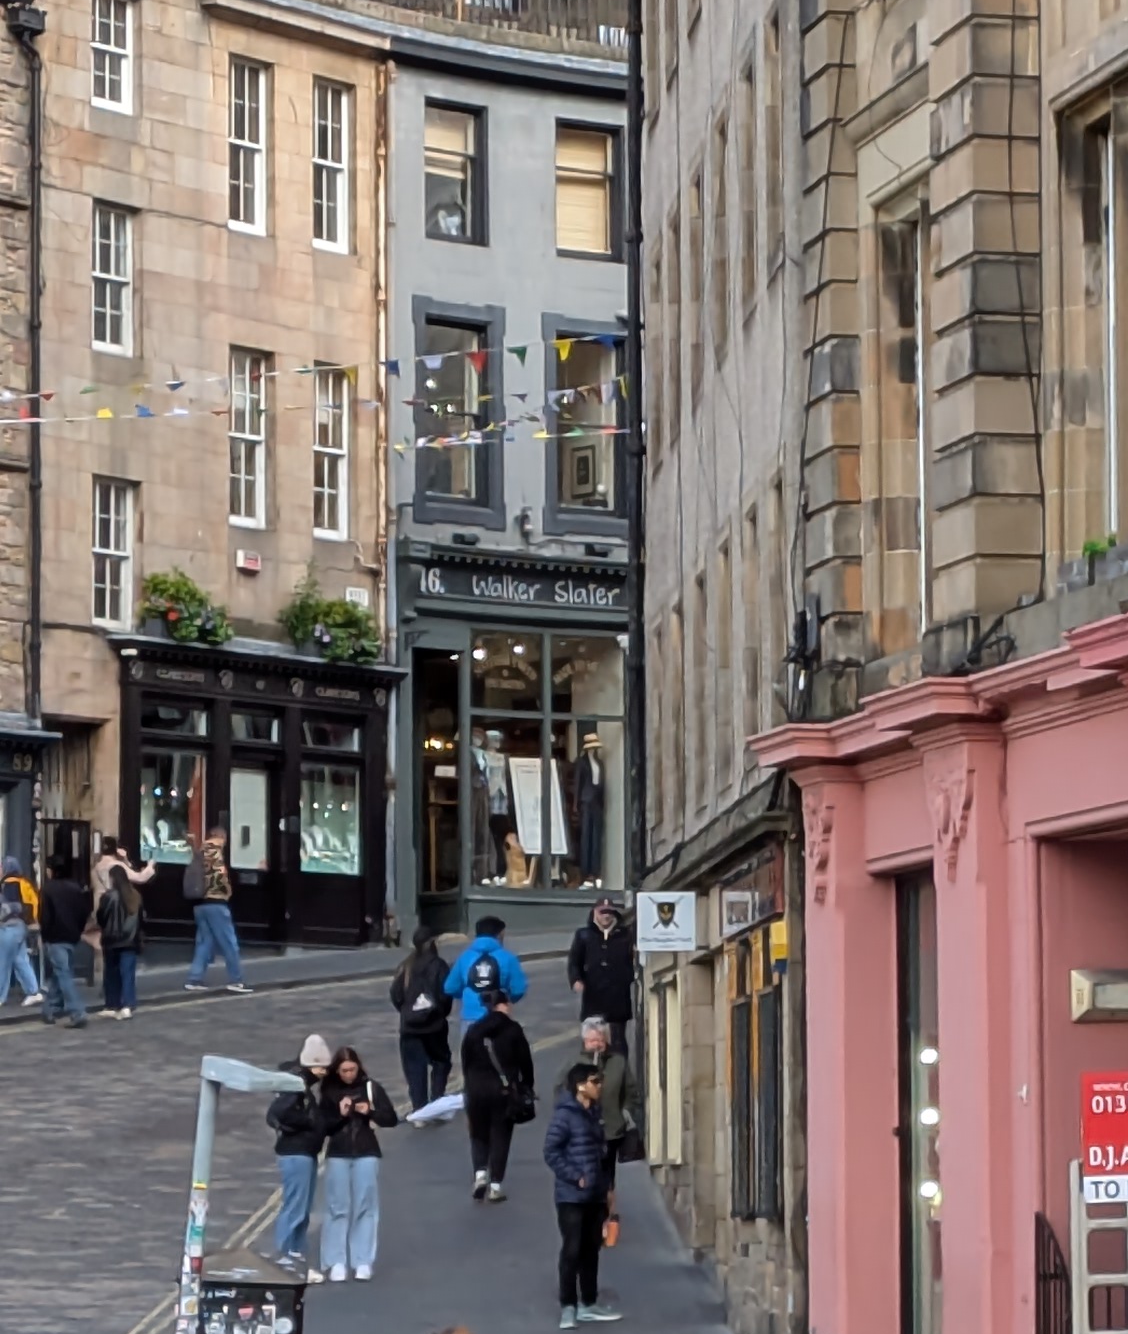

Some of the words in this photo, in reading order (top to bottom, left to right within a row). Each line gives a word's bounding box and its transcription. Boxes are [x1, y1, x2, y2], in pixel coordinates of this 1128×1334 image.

[472, 574, 541, 602] Walker
[554, 577, 621, 606] Slater
[1090, 1180, 1121, 1200] TO
